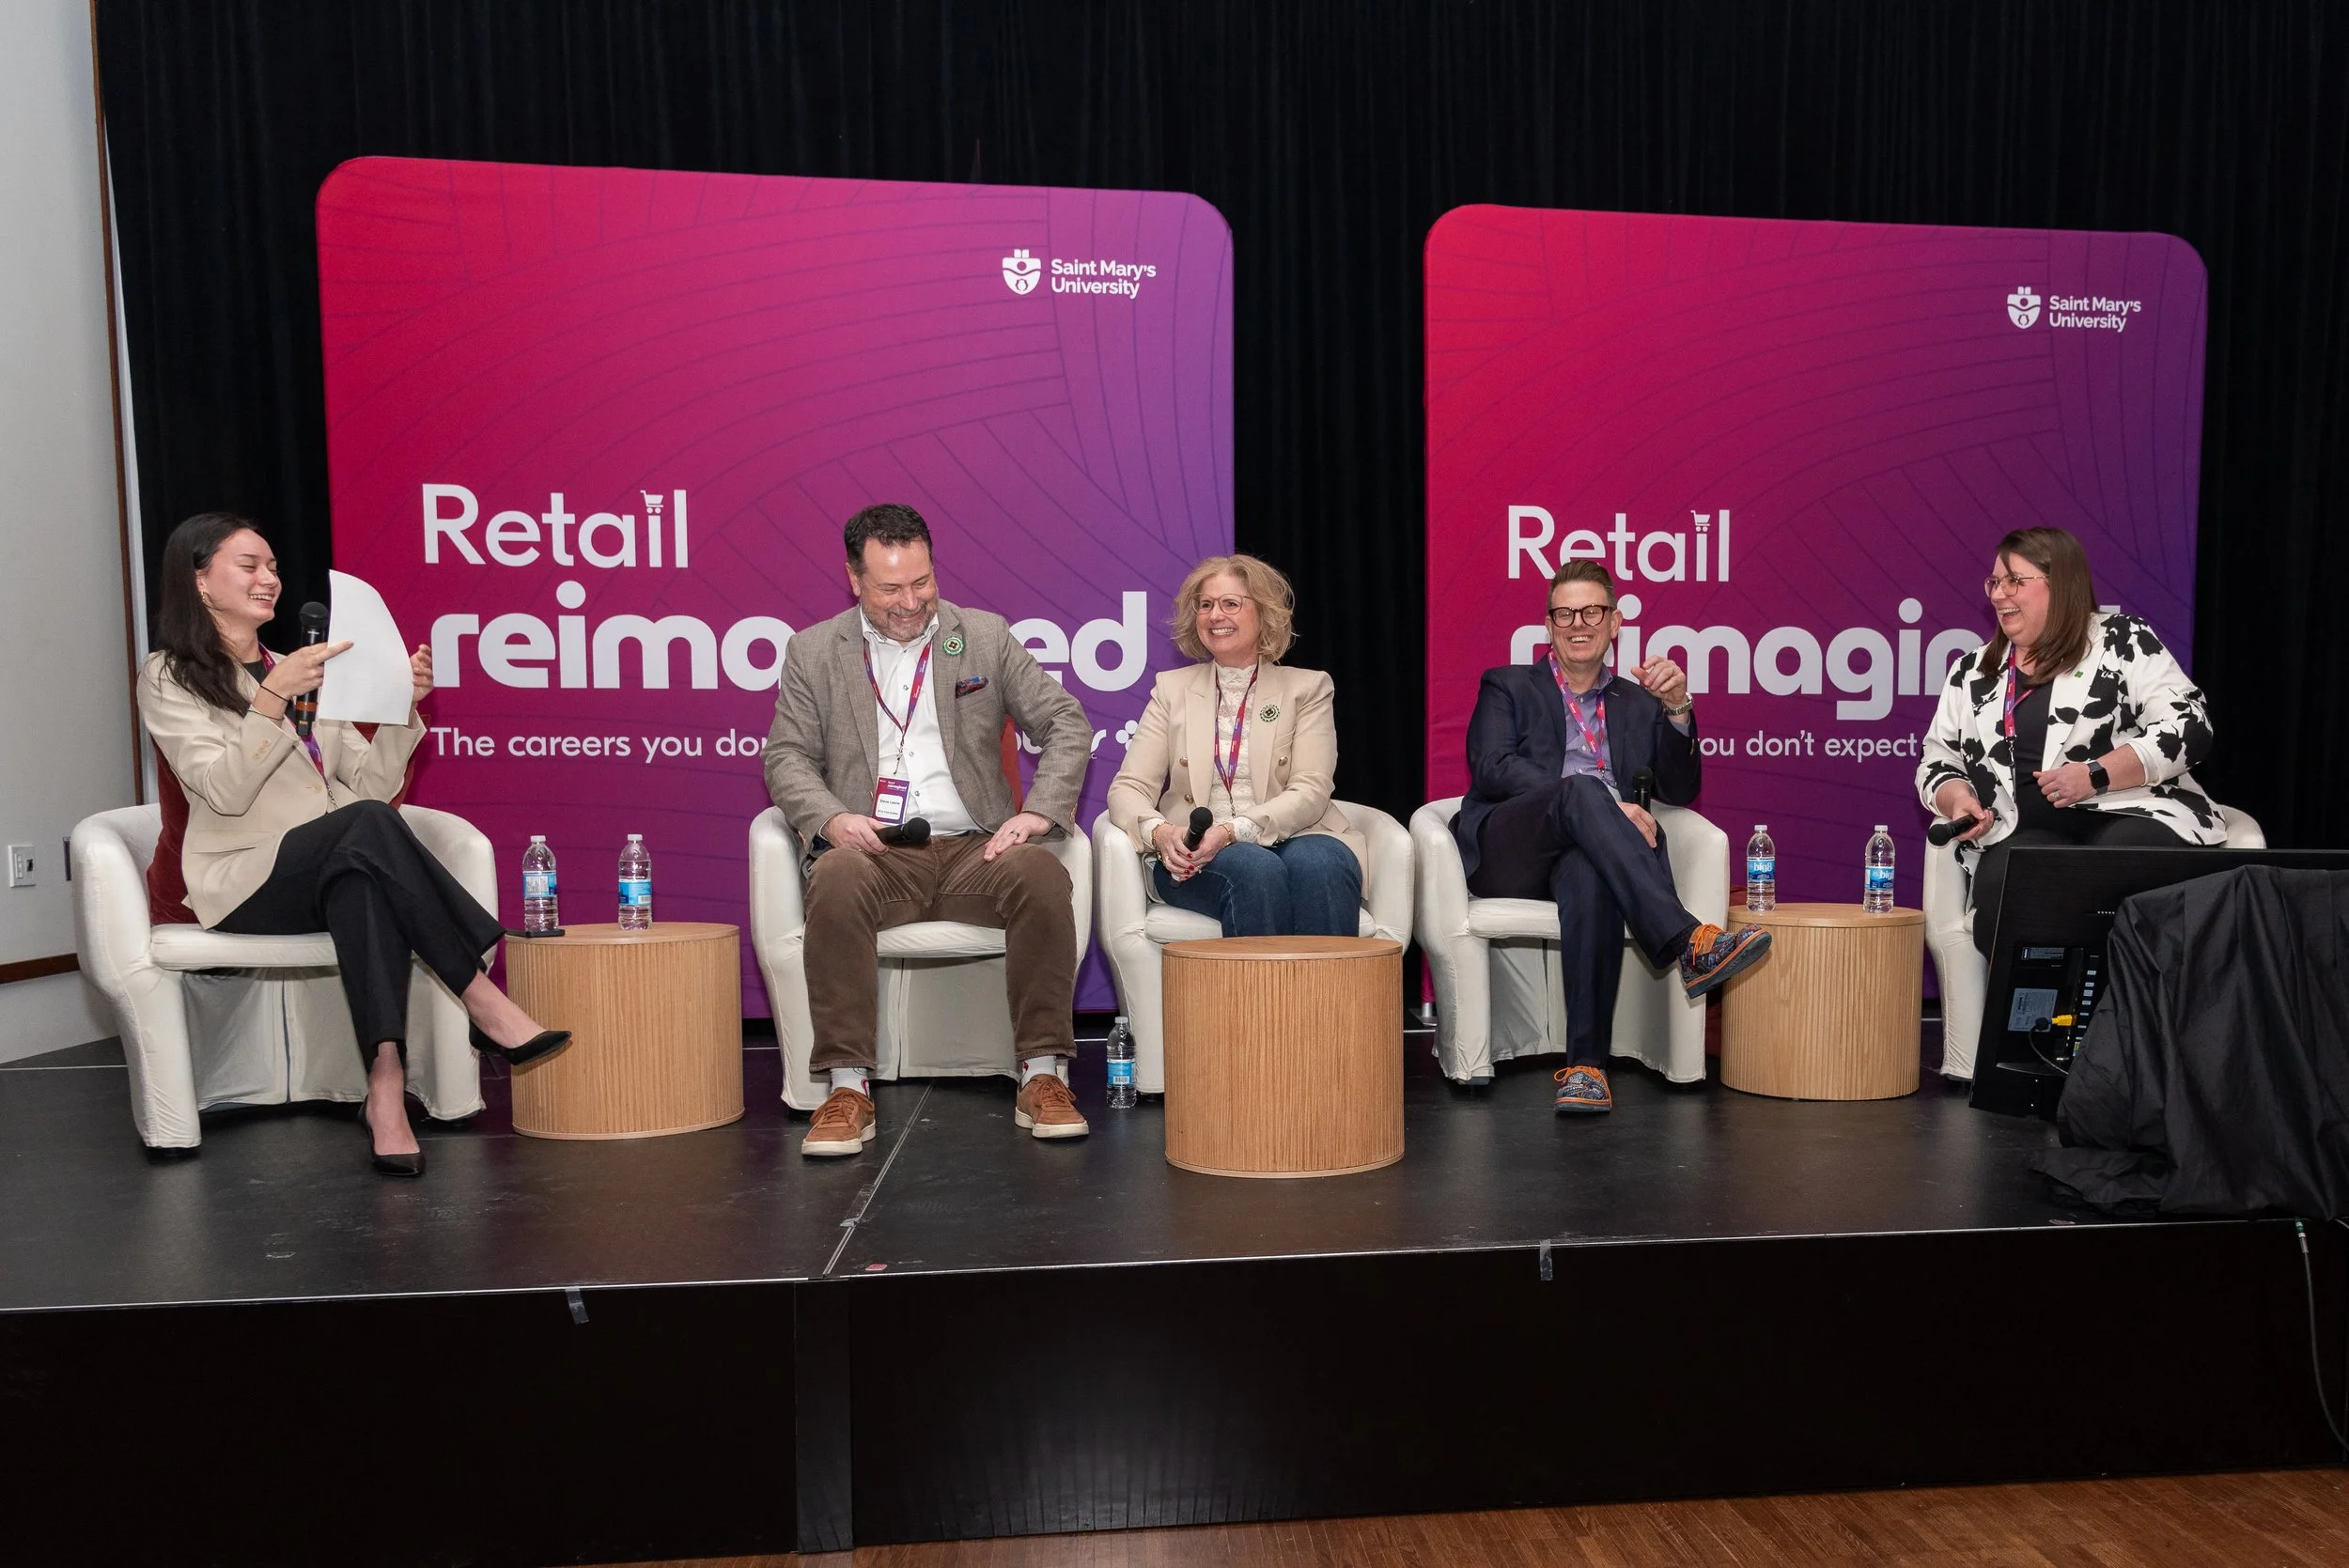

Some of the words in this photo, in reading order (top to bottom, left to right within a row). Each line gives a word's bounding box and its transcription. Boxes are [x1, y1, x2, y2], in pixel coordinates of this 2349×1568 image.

[1050, 258, 1097, 276] Saint
[1099, 259, 1157, 282] Mary's
[1050, 276, 1140, 300] University
[2048, 295, 2090, 311] Saint
[2092, 296, 2141, 316] Mary's
[2048, 312, 2126, 333] University
[423, 483, 689, 568] Retail
[1508, 505, 1730, 582] Retail
[430, 580, 1147, 692] reimaed
[429, 727, 495, 756] The
[507, 736, 631, 756] careers
[642, 737, 702, 764] you
[1697, 737, 1735, 756] ou
[1746, 730, 1814, 756] don't
[1825, 733, 1918, 763] expect
